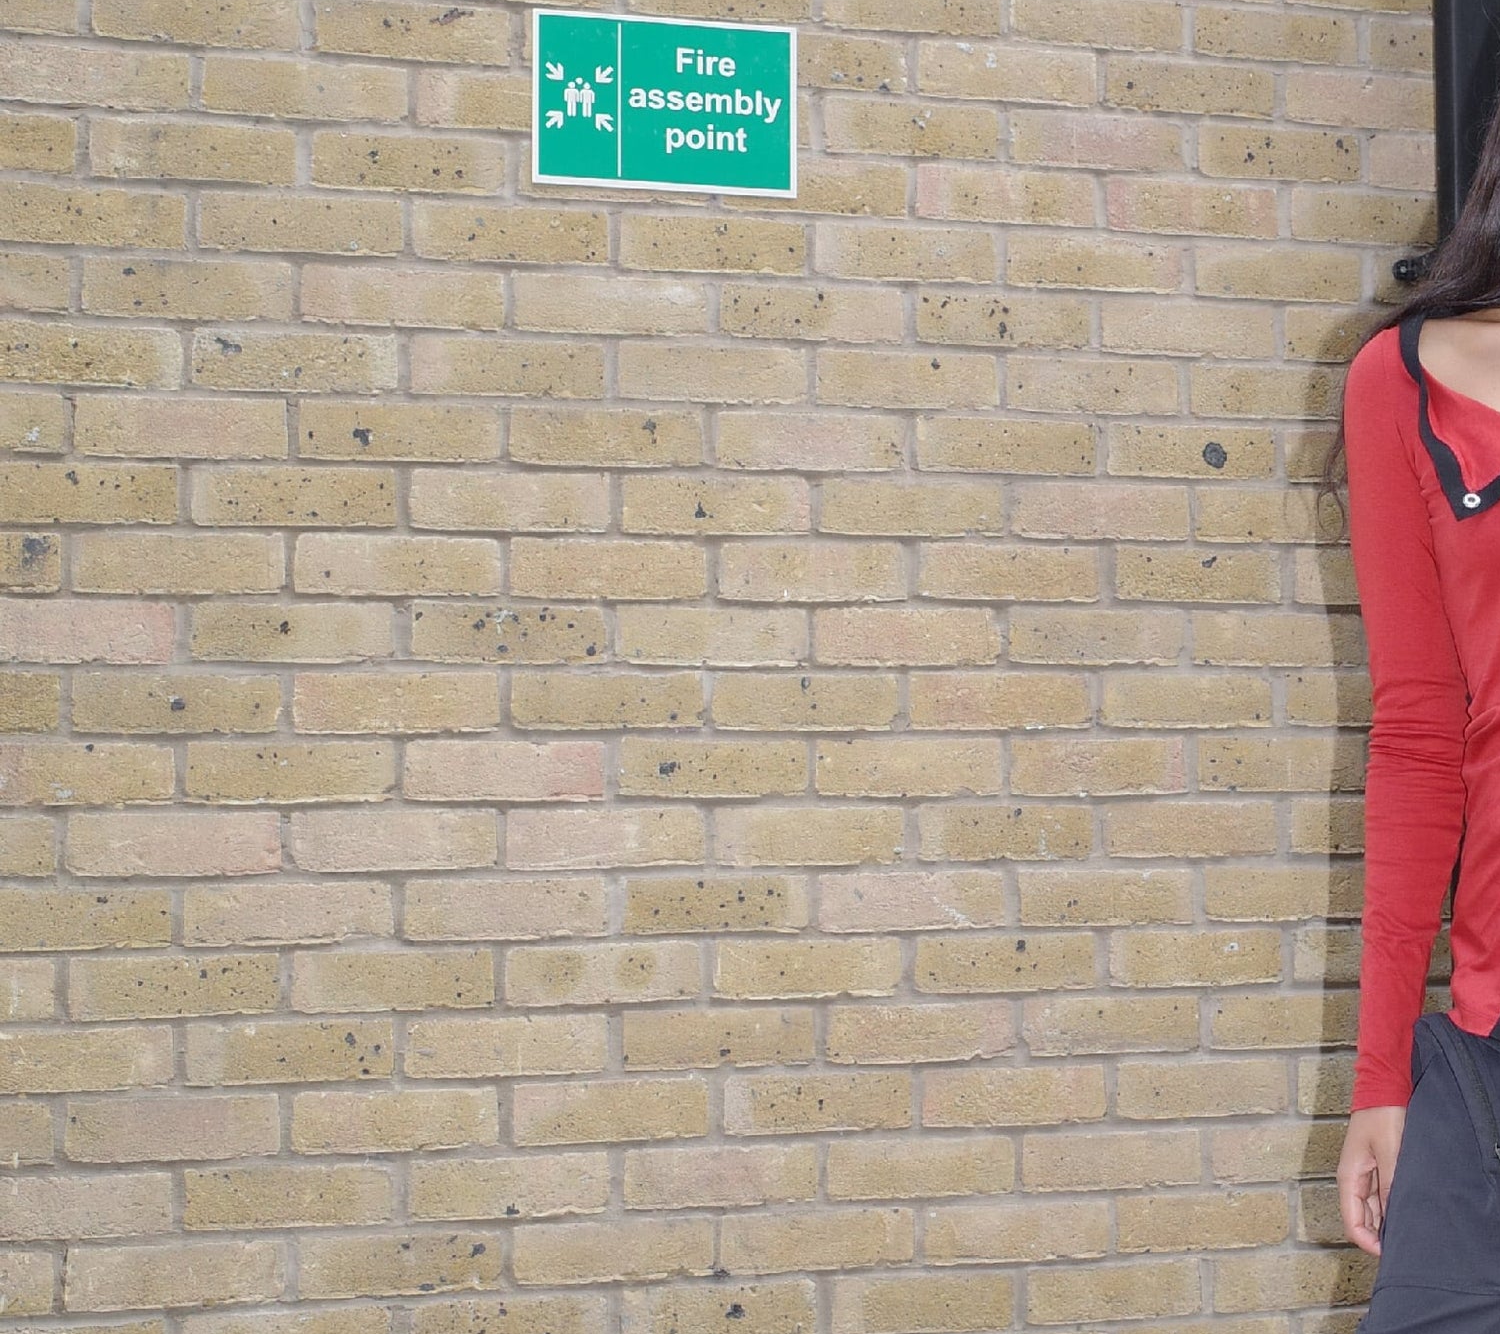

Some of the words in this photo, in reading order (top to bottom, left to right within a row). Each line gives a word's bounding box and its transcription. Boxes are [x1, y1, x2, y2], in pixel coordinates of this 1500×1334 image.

[675, 46, 736, 77] Fire
[628, 87, 782, 124] assembly
[665, 123, 748, 154] point
